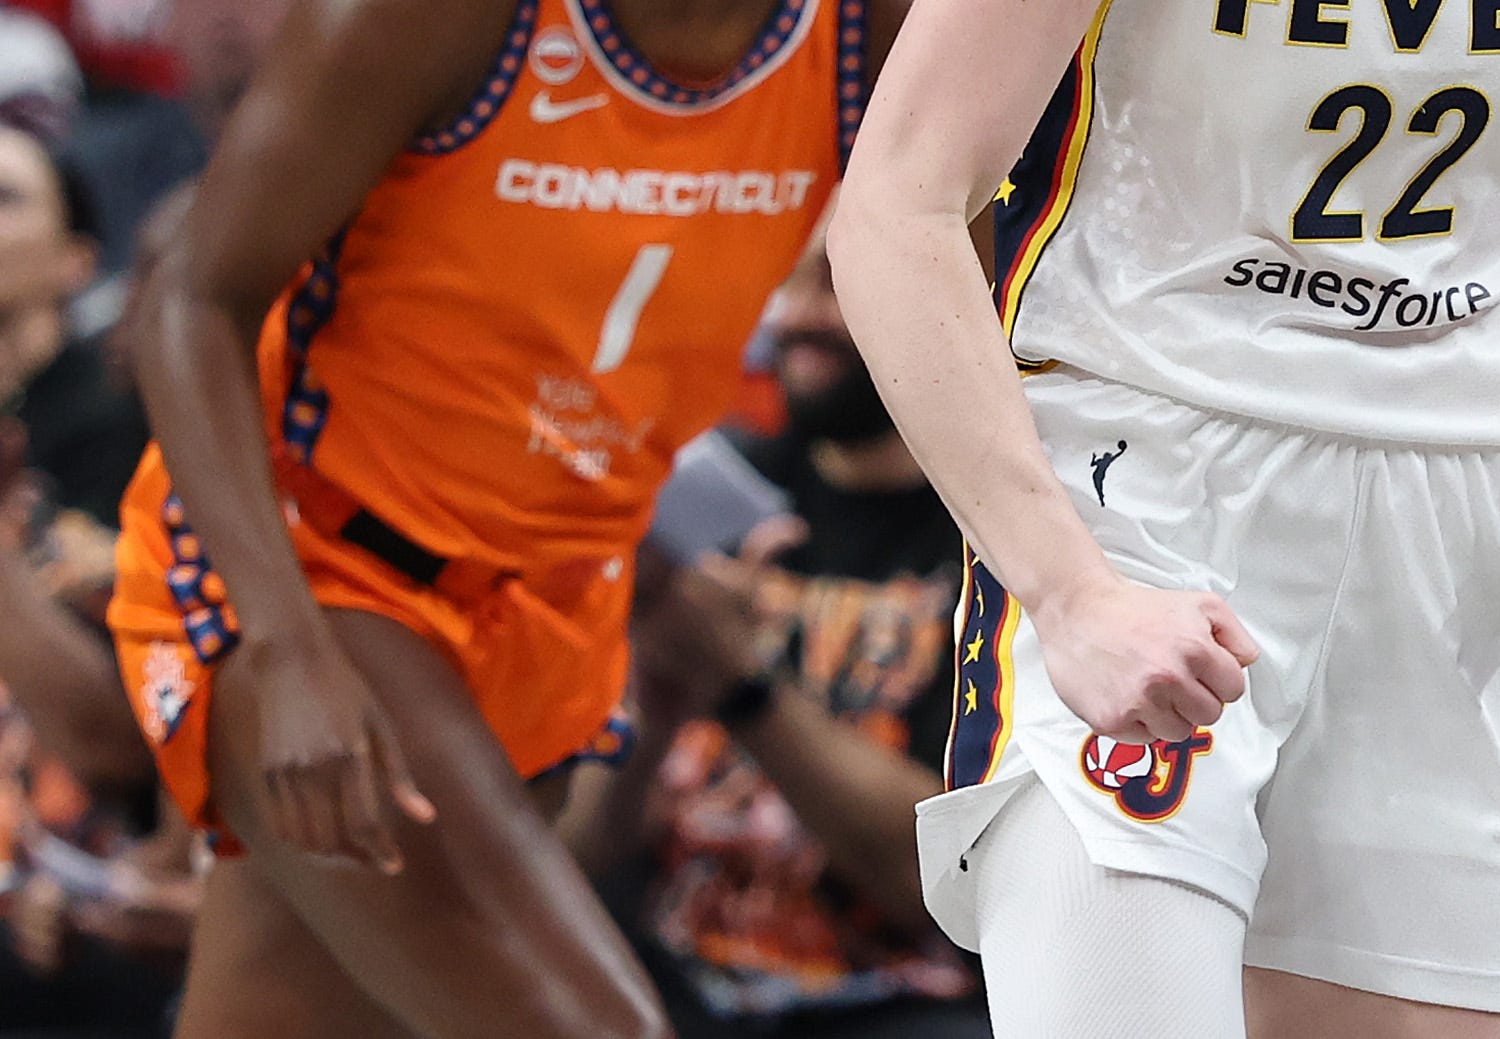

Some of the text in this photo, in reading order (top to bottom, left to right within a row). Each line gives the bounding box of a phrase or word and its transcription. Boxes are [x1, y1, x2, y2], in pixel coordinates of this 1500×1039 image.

[496, 158, 817, 217] CONNECTICUT
[1289, 81, 1494, 243] 22
[591, 242, 675, 375] 1
